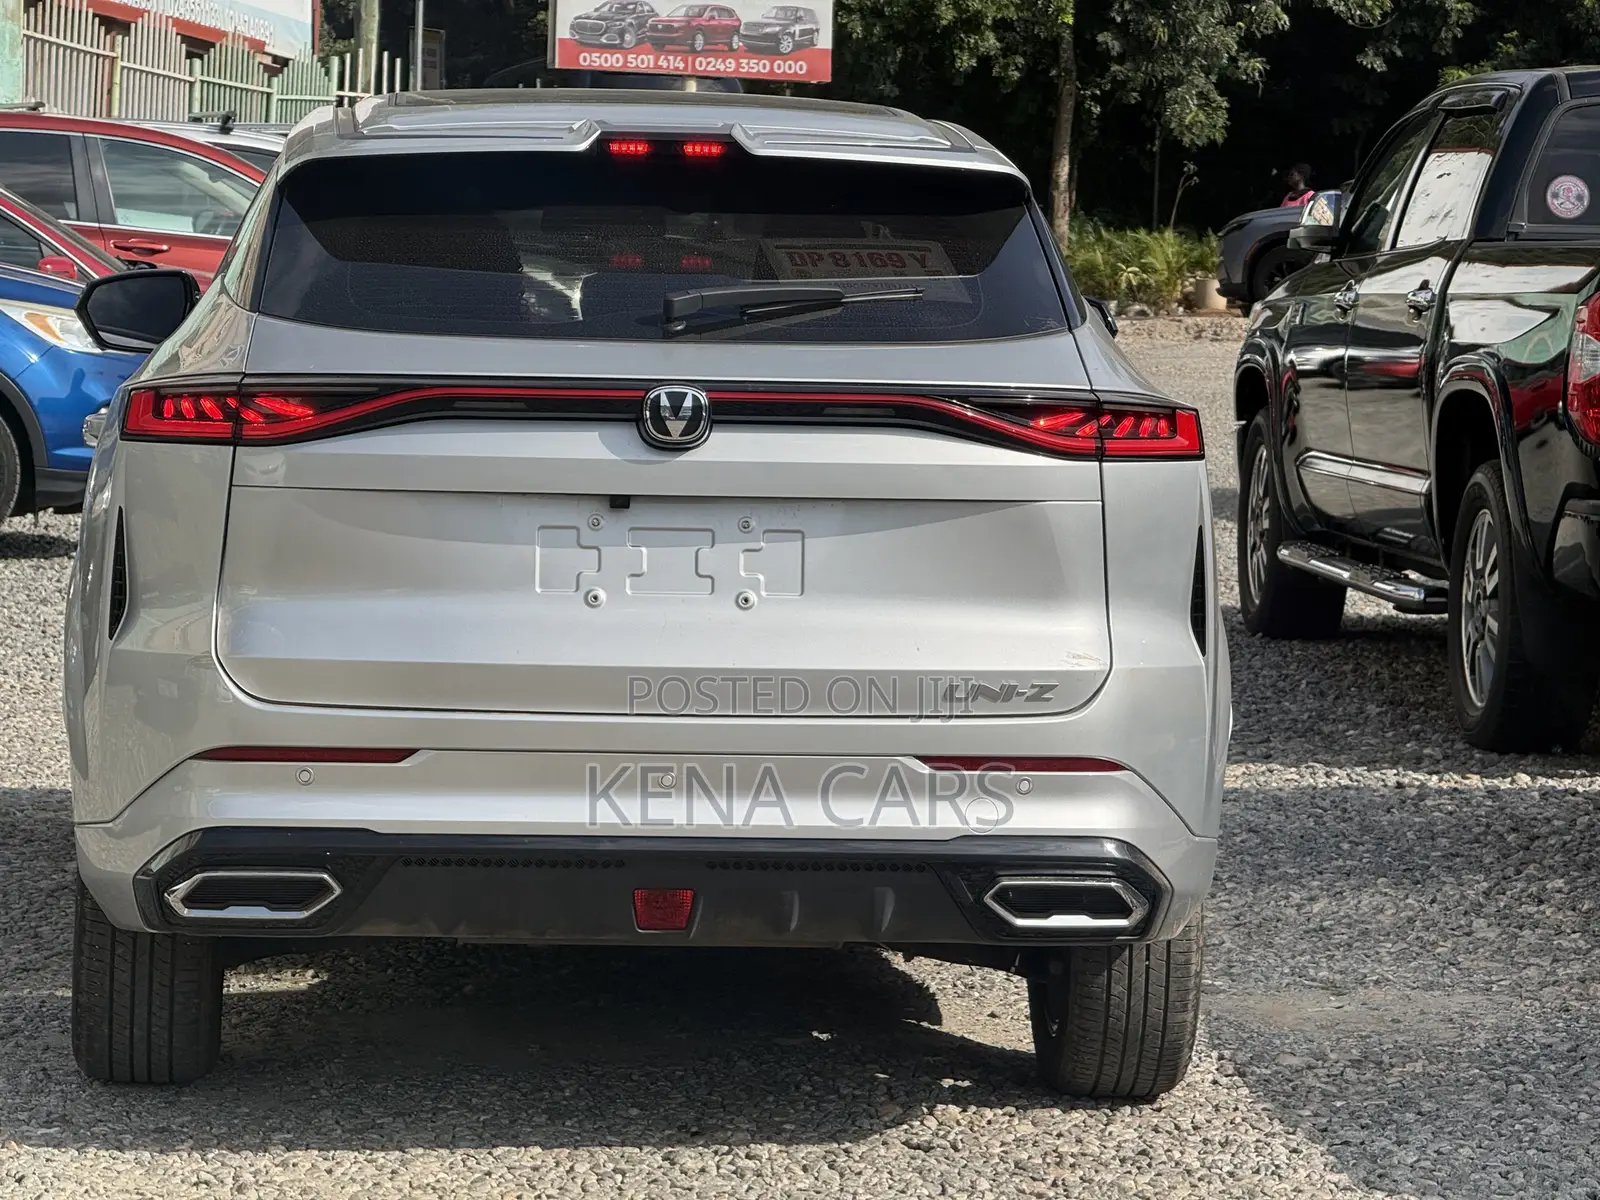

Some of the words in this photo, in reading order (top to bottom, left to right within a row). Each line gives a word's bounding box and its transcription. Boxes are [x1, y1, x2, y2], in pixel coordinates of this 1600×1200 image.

[578, 52, 624, 68] 0500
[626, 54, 654, 69] 501
[657, 55, 685, 71] 414
[695, 57, 735, 72] 0249
[739, 58, 769, 73] 350
[773, 59, 808, 75] 000
[942, 682, 1060, 704] UNI-Z
